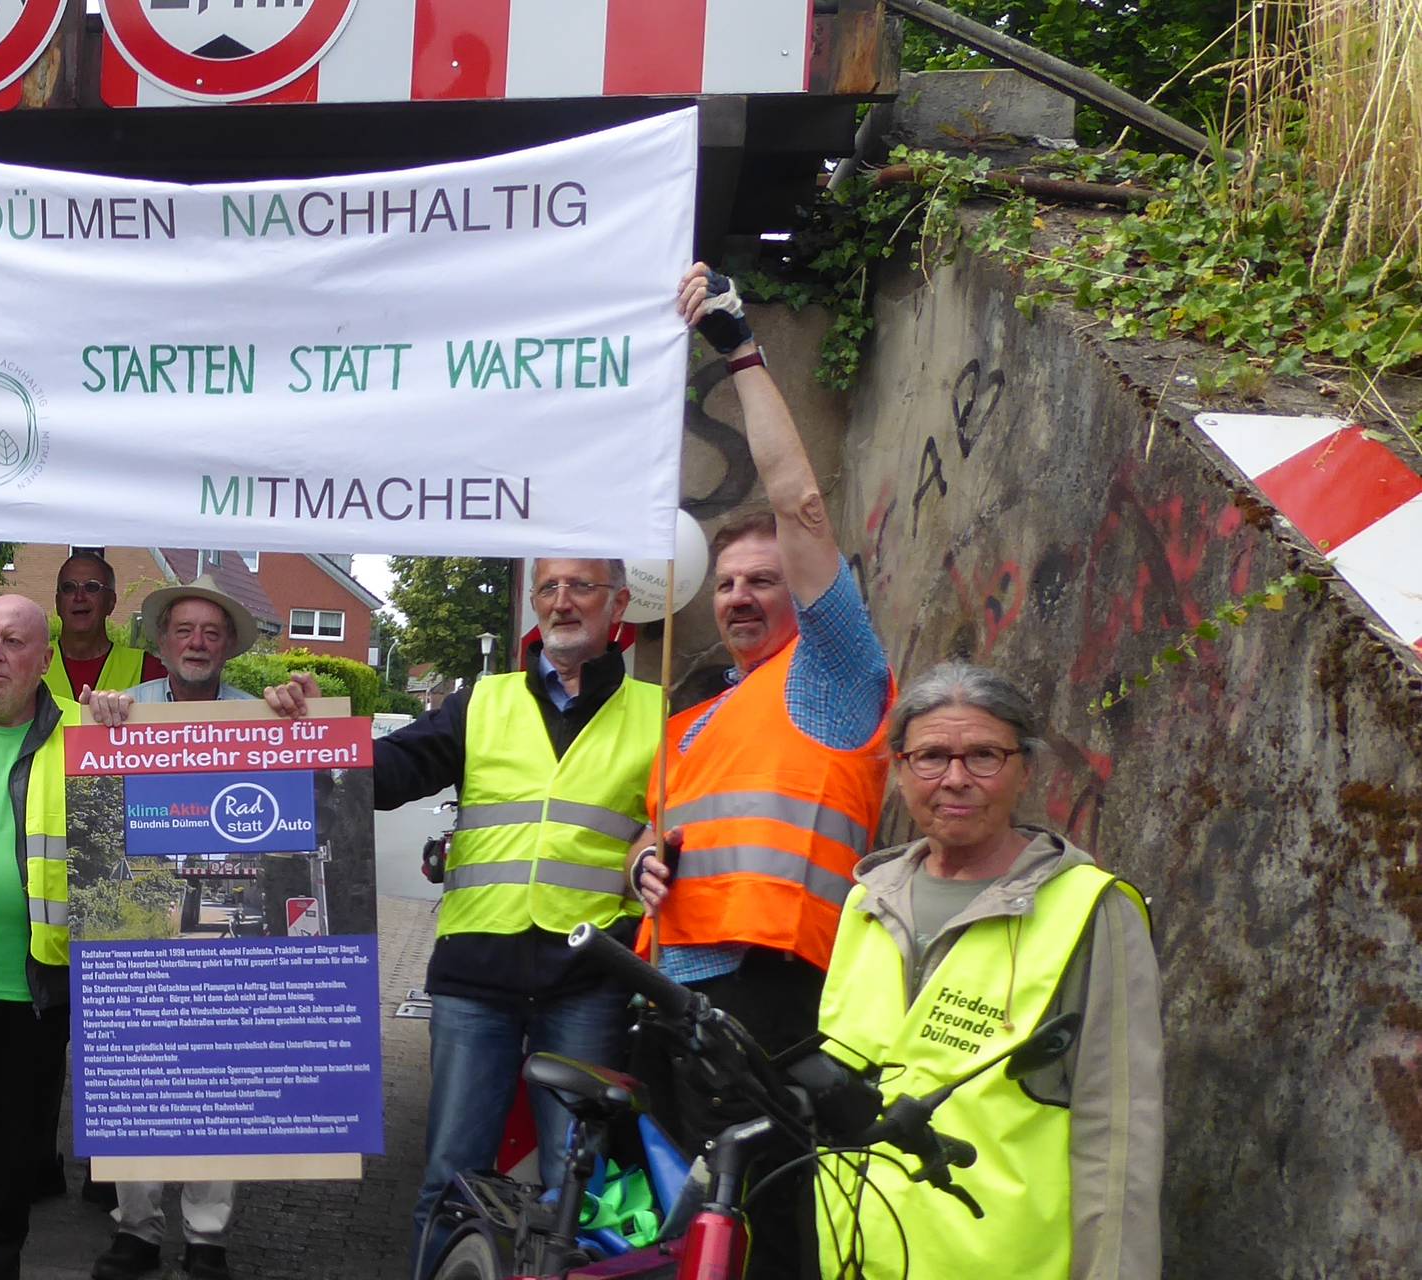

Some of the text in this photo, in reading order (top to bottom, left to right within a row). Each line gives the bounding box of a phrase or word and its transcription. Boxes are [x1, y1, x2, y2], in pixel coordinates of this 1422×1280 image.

[221, 180, 589, 238] NACHHALTIG
[81, 335, 631, 395] STARTEN STATT WARTEN
[199, 474, 530, 522] MITMACHEN
[109, 721, 329, 747] Unterführung für
[79, 743, 358, 771] Autoverkehr sperren!
[127, 794, 265, 818] klimaAktiv Rad
[130, 818, 312, 833] Bündnis Dülmen statt Auto
[937, 986, 1006, 1022] Friedens
[928, 1005, 995, 1038] Freunde
[920, 1023, 981, 1055] Dülmen
